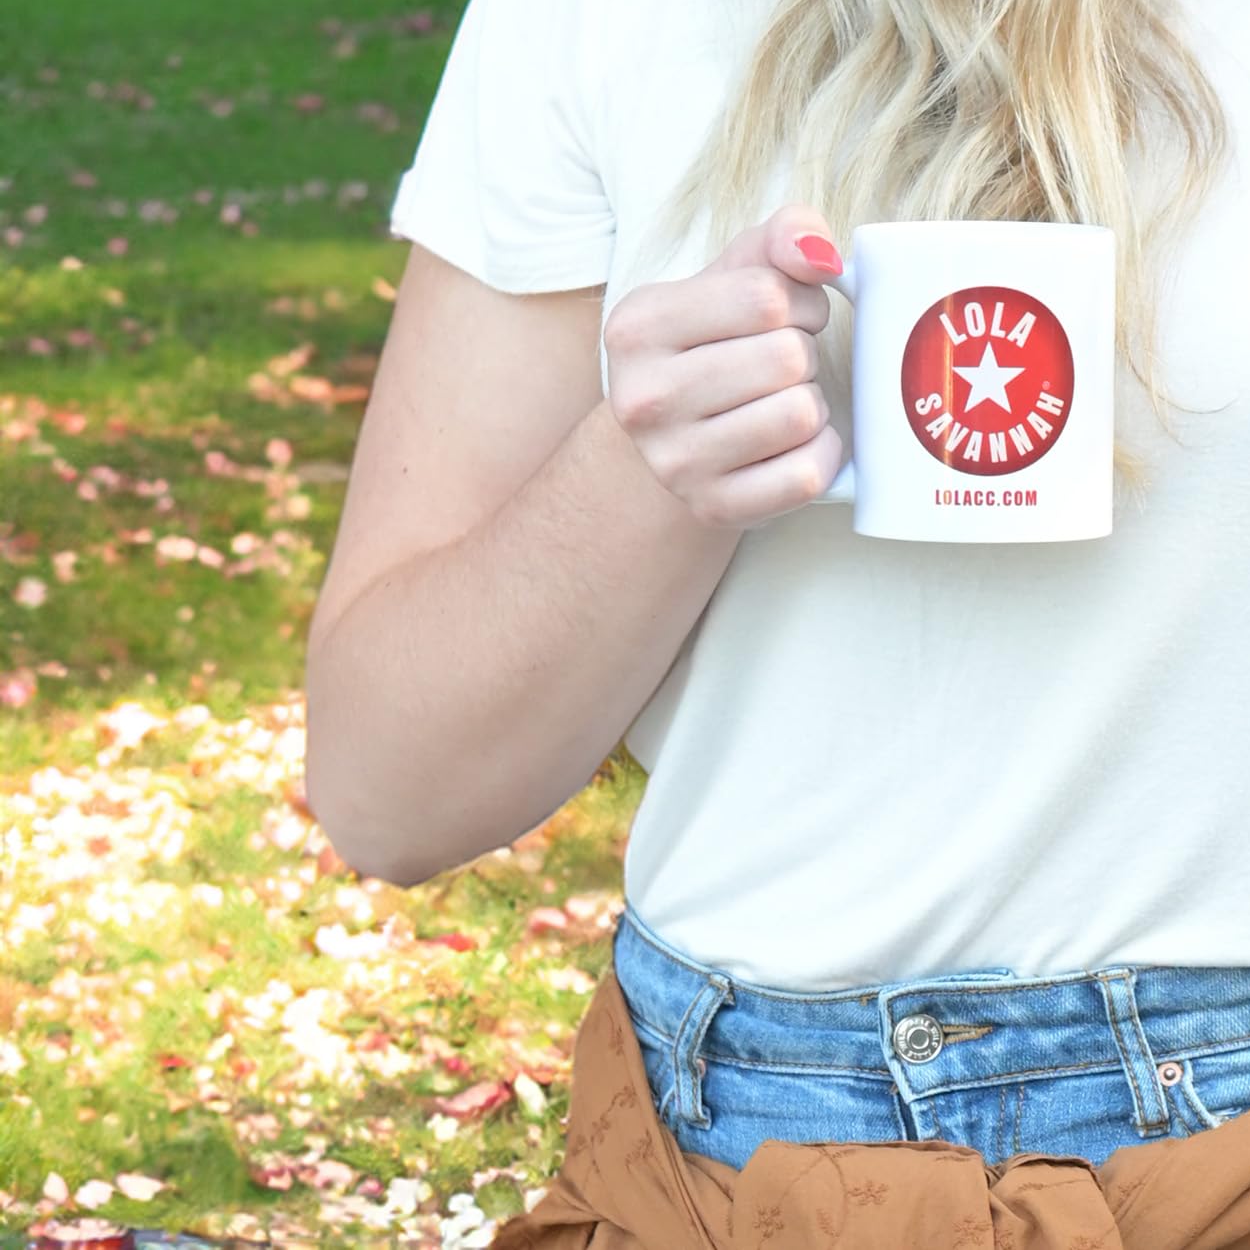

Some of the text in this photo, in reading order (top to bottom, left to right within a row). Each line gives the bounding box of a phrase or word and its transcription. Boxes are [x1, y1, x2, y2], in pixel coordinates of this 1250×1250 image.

[939, 302, 1037, 348] LOLA
[915, 392, 1065, 463] SAVANNAH
[935, 489, 1037, 507] LOLACC.COM
